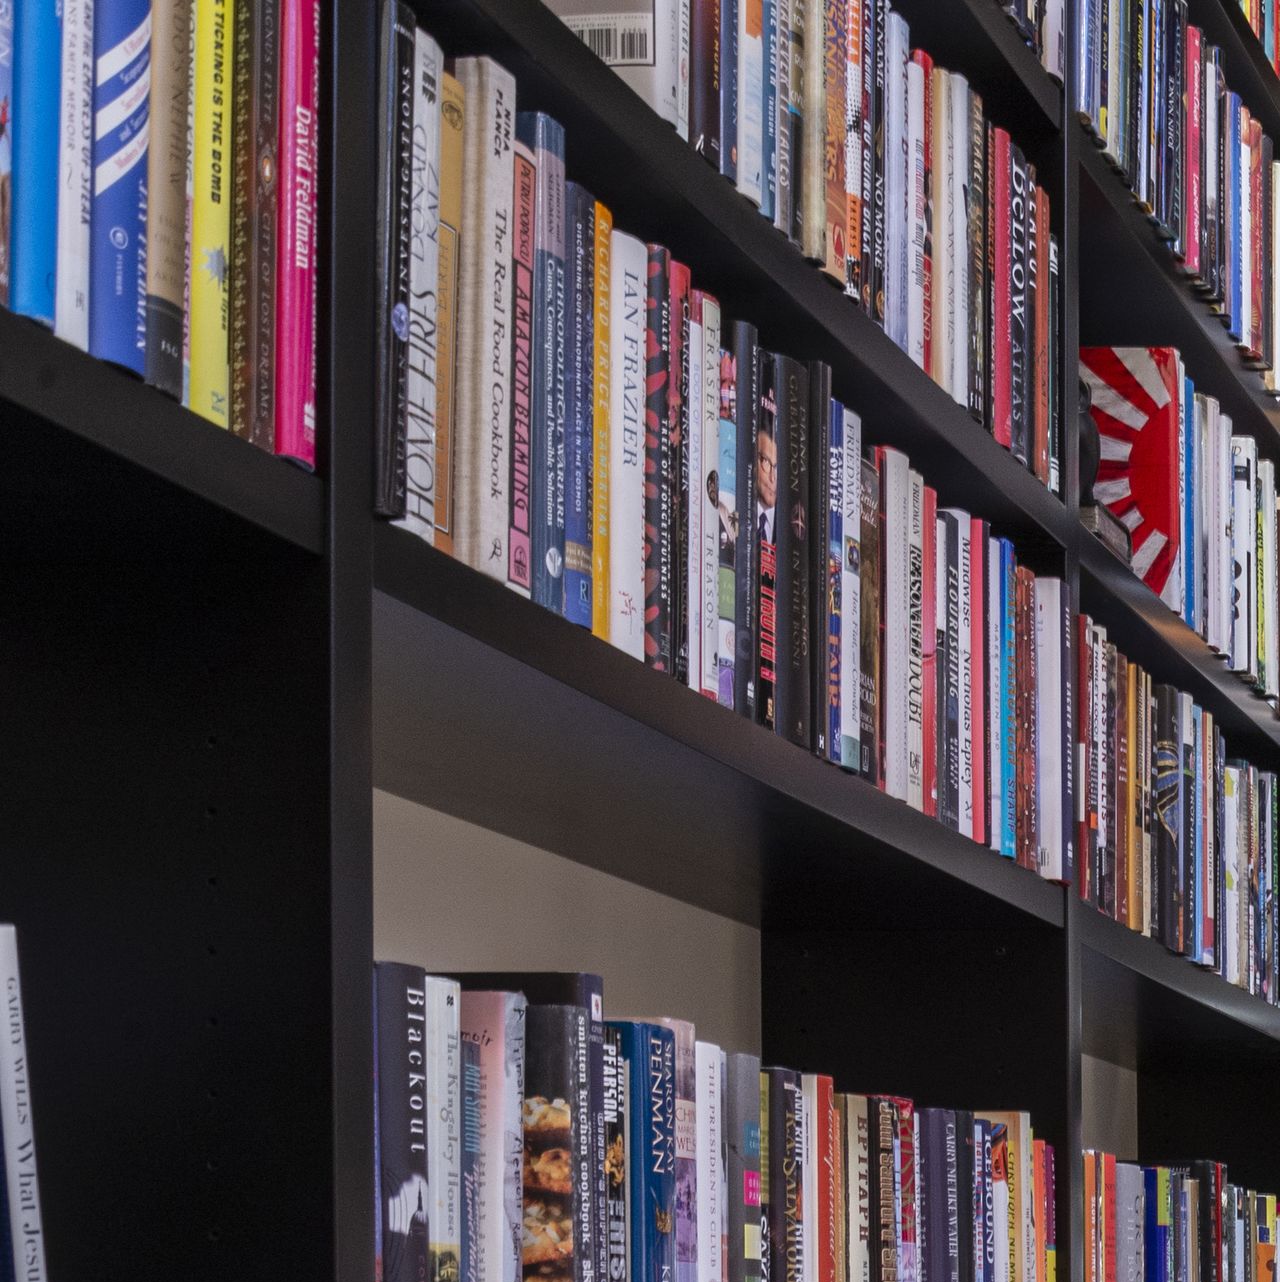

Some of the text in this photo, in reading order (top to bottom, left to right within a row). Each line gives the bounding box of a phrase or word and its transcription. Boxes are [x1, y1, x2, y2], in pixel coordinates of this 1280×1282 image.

[296, 104, 311, 270] David Feldman
[621, 267, 639, 468] IAN FRAZIER
[407, 986, 426, 1154] Blackout
[18, 1140, 36, 1211] What
